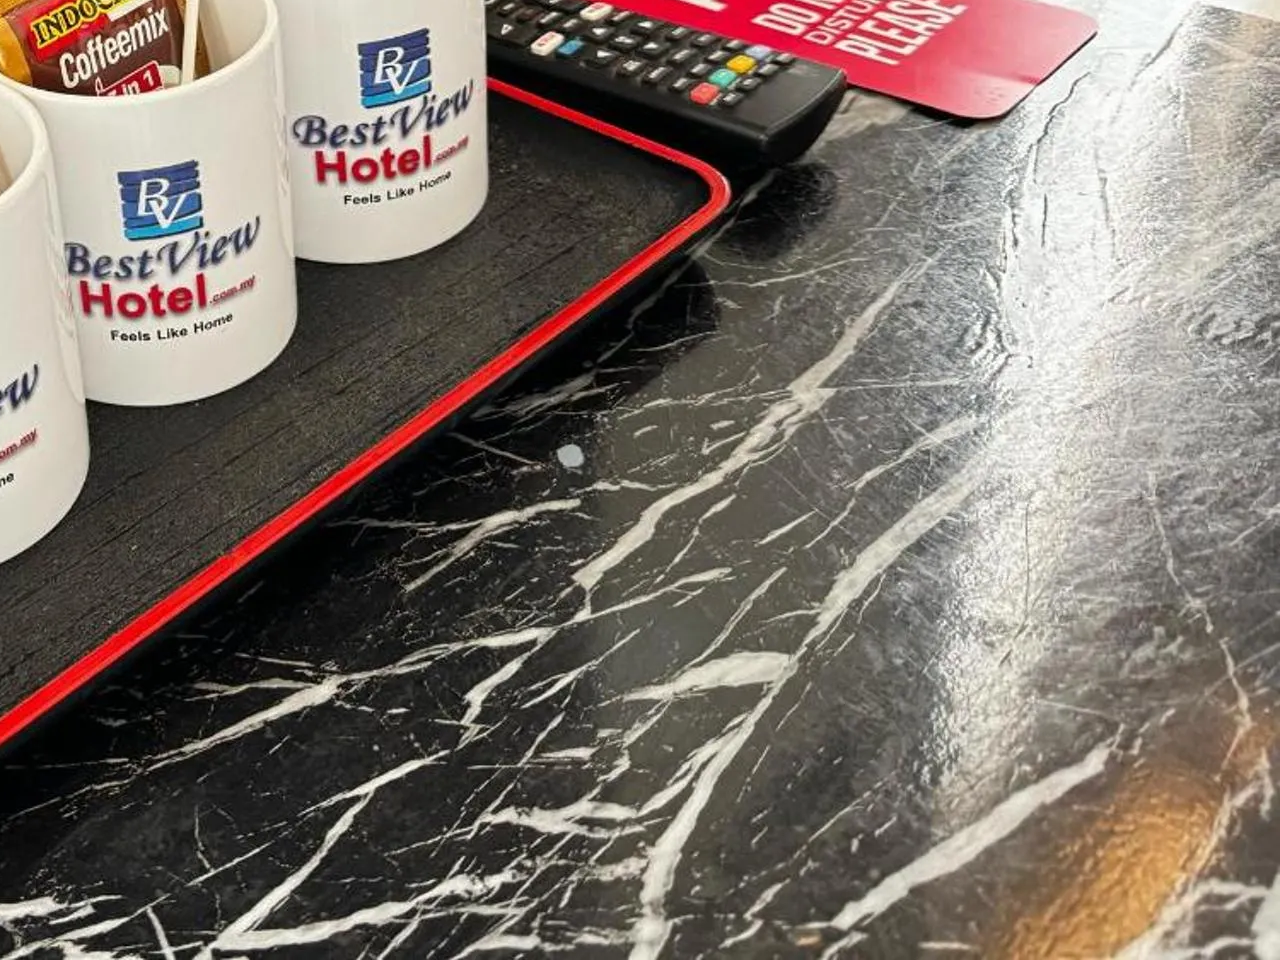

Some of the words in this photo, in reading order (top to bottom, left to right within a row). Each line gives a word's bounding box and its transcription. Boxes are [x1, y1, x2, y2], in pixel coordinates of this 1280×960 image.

[750, 2, 823, 36] DO
[59, 6, 169, 89] Coffeemix
[343, 193, 381, 205] Feels
[387, 187, 415, 201] Like
[419, 171, 452, 192] Home
[110, 329, 151, 342] Feels
[157, 327, 189, 340] Like
[193, 312, 233, 333] Home
